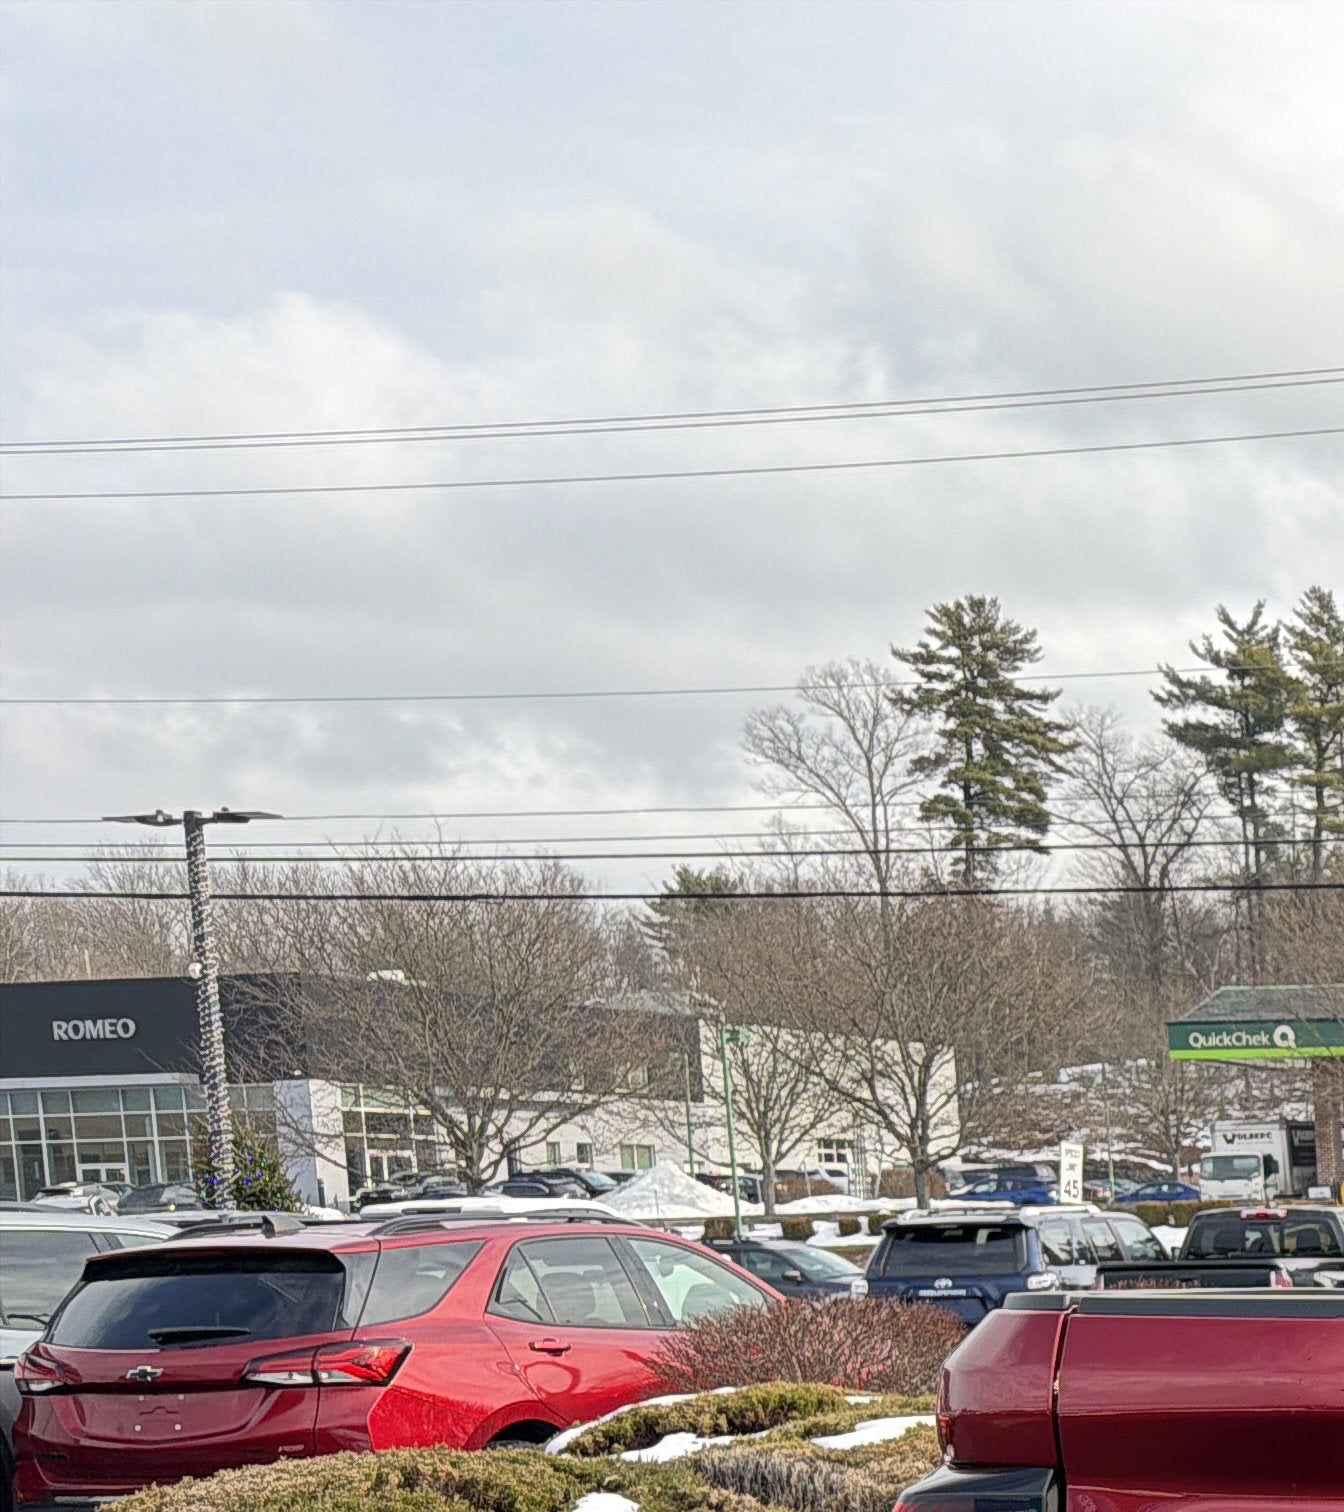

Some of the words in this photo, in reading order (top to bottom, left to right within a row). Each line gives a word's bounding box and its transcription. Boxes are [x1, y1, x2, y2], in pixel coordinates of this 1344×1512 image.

[52, 1018, 136, 1041] ROMEO
[1188, 1031, 1271, 1049] QuickChek
[1063, 1179, 1080, 1199] 45
